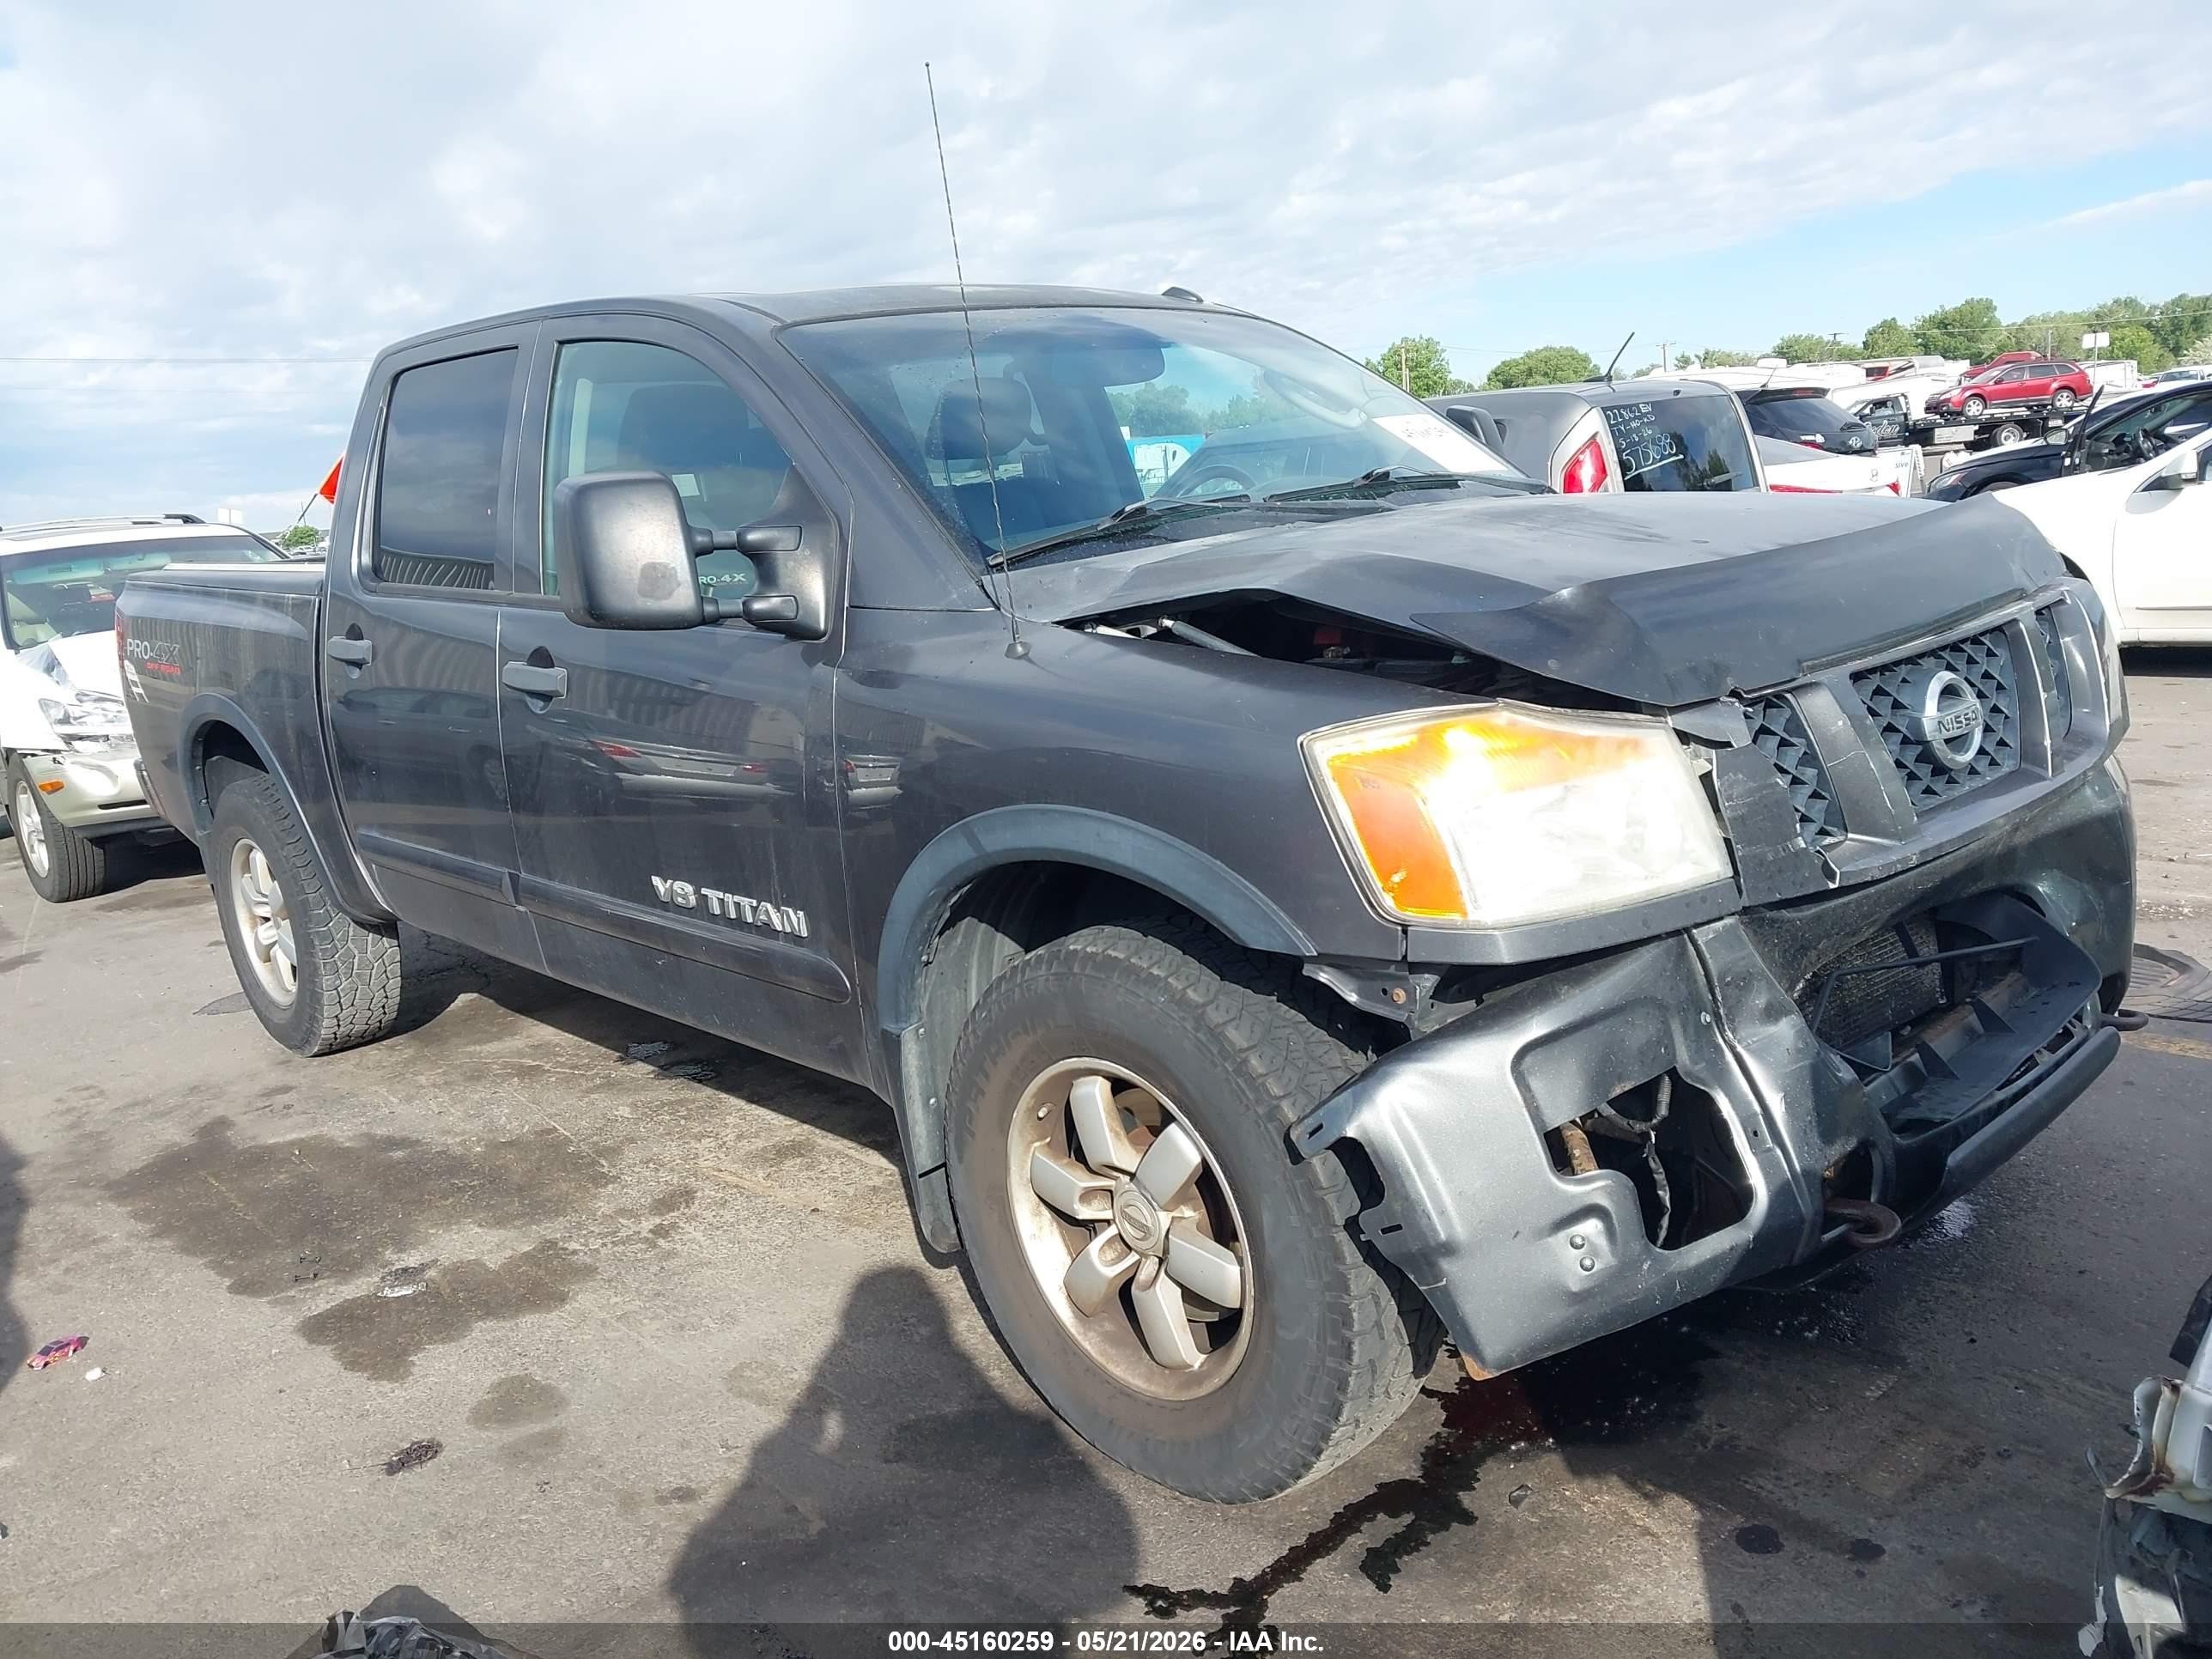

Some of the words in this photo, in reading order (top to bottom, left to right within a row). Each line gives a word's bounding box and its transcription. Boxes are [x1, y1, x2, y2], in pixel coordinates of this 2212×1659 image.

[1619, 427, 1653, 448] 5-18-26
[1622, 433, 1676, 474] 575688
[698, 573, 747, 585] RO-4X
[651, 875, 696, 908] V8
[701, 887, 809, 938] TITAN
